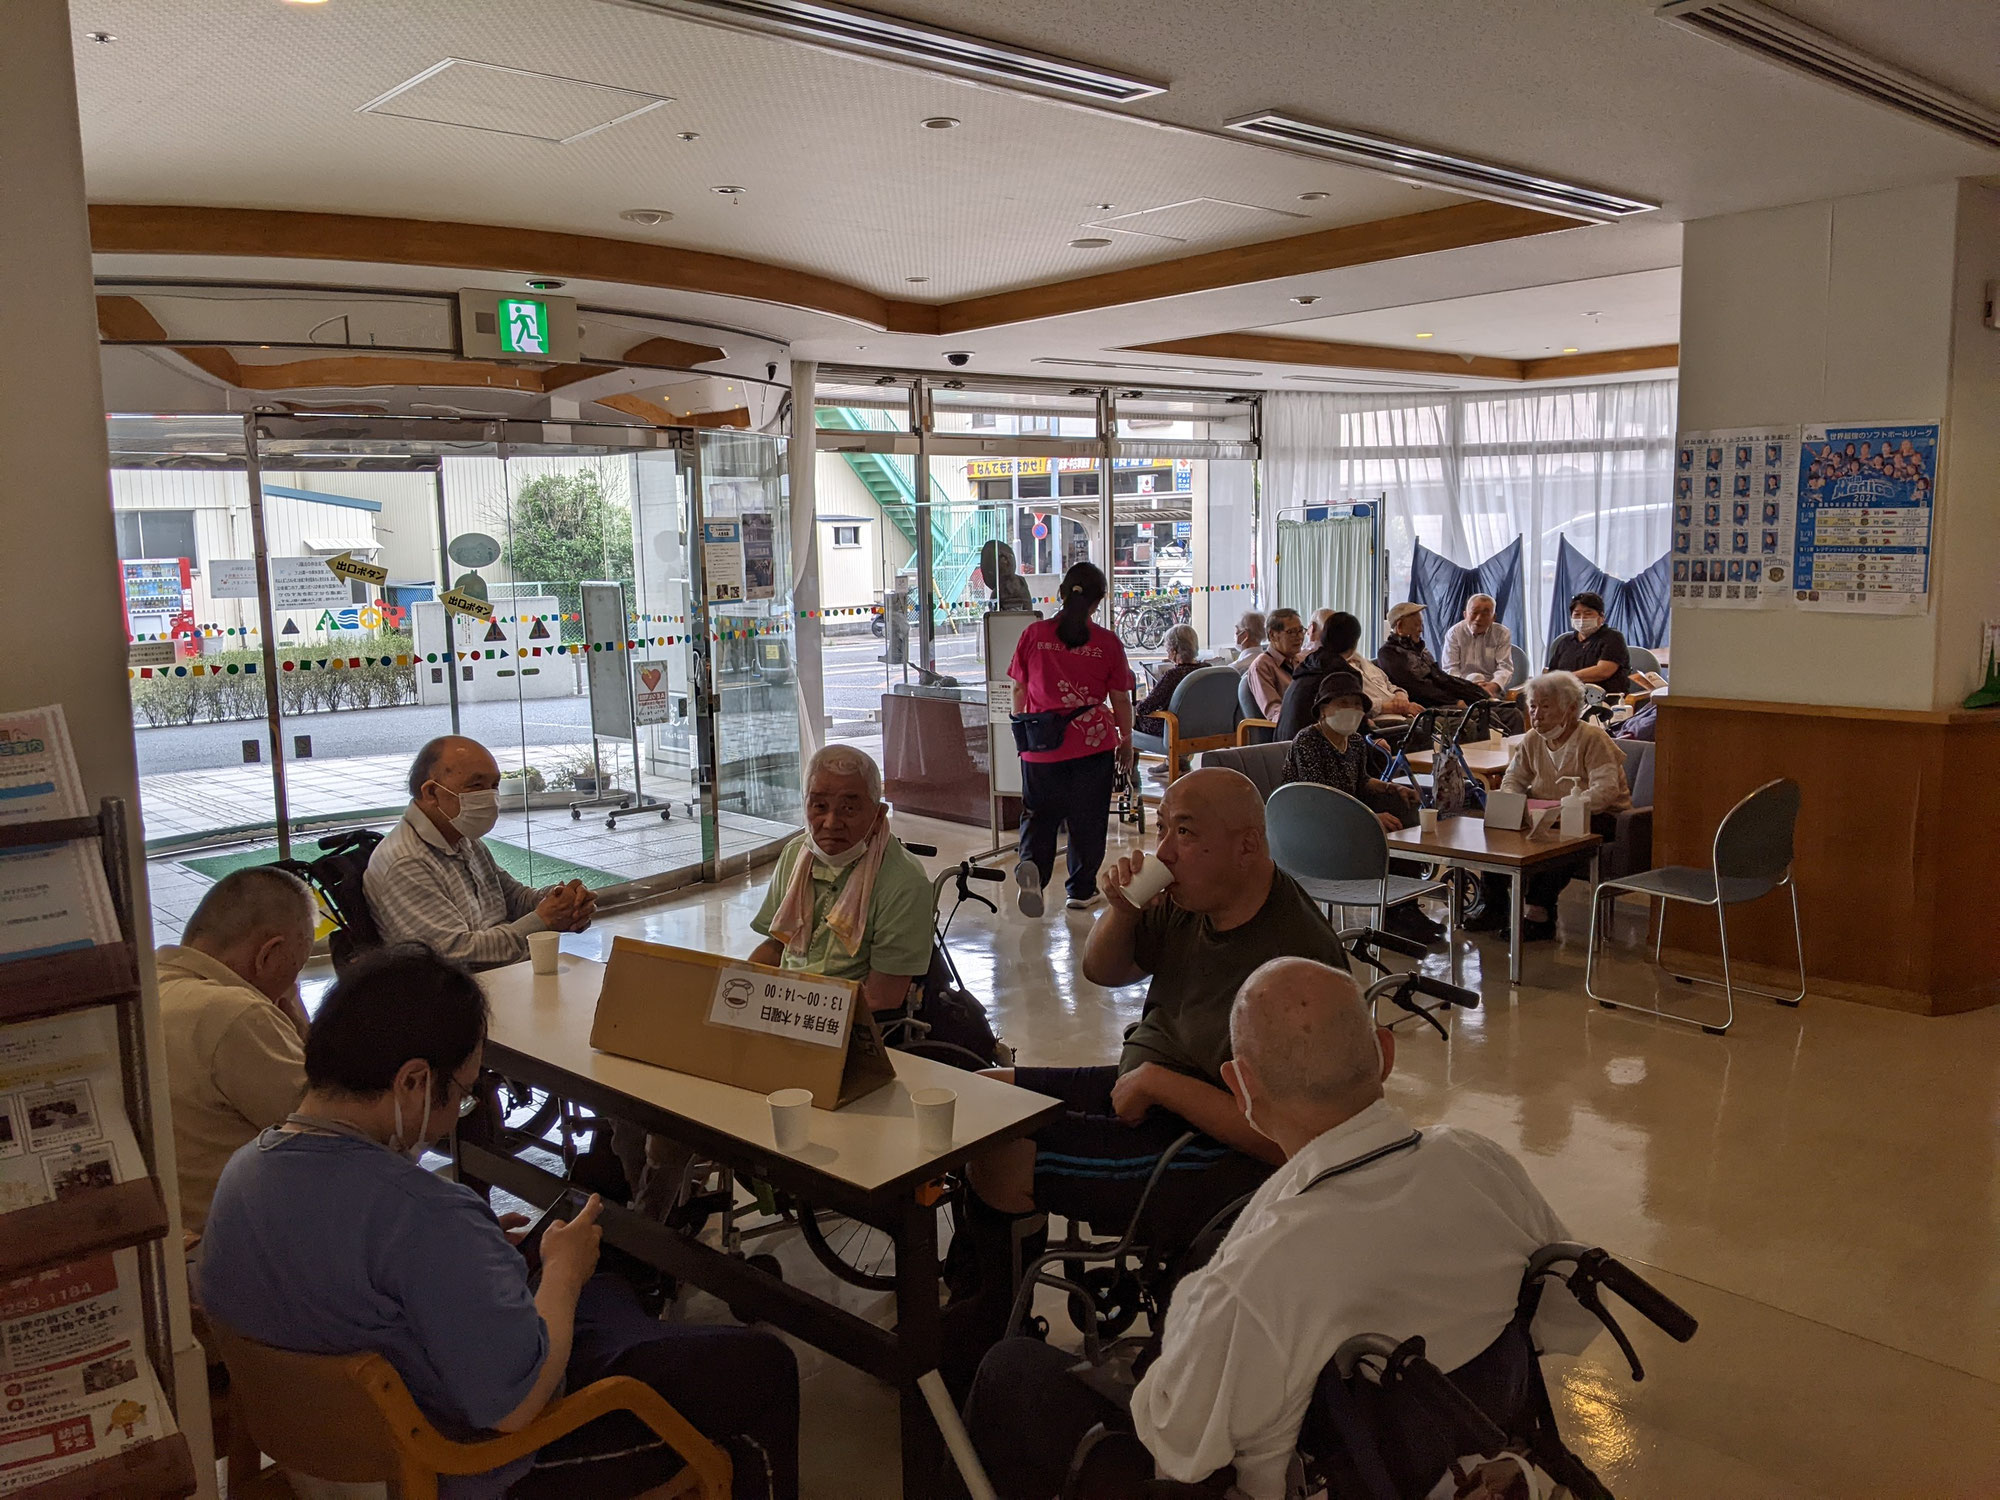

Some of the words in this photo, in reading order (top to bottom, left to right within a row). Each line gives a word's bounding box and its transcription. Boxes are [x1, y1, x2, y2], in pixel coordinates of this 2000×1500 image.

[1830, 430, 1932, 440] 世界最強のソフトボールリーグ
[336, 561, 384, 580] 出口ボタン
[448, 596, 490, 615] 出口ボタン
[760, 1005, 840, 1035] 毎月第4木曜日
